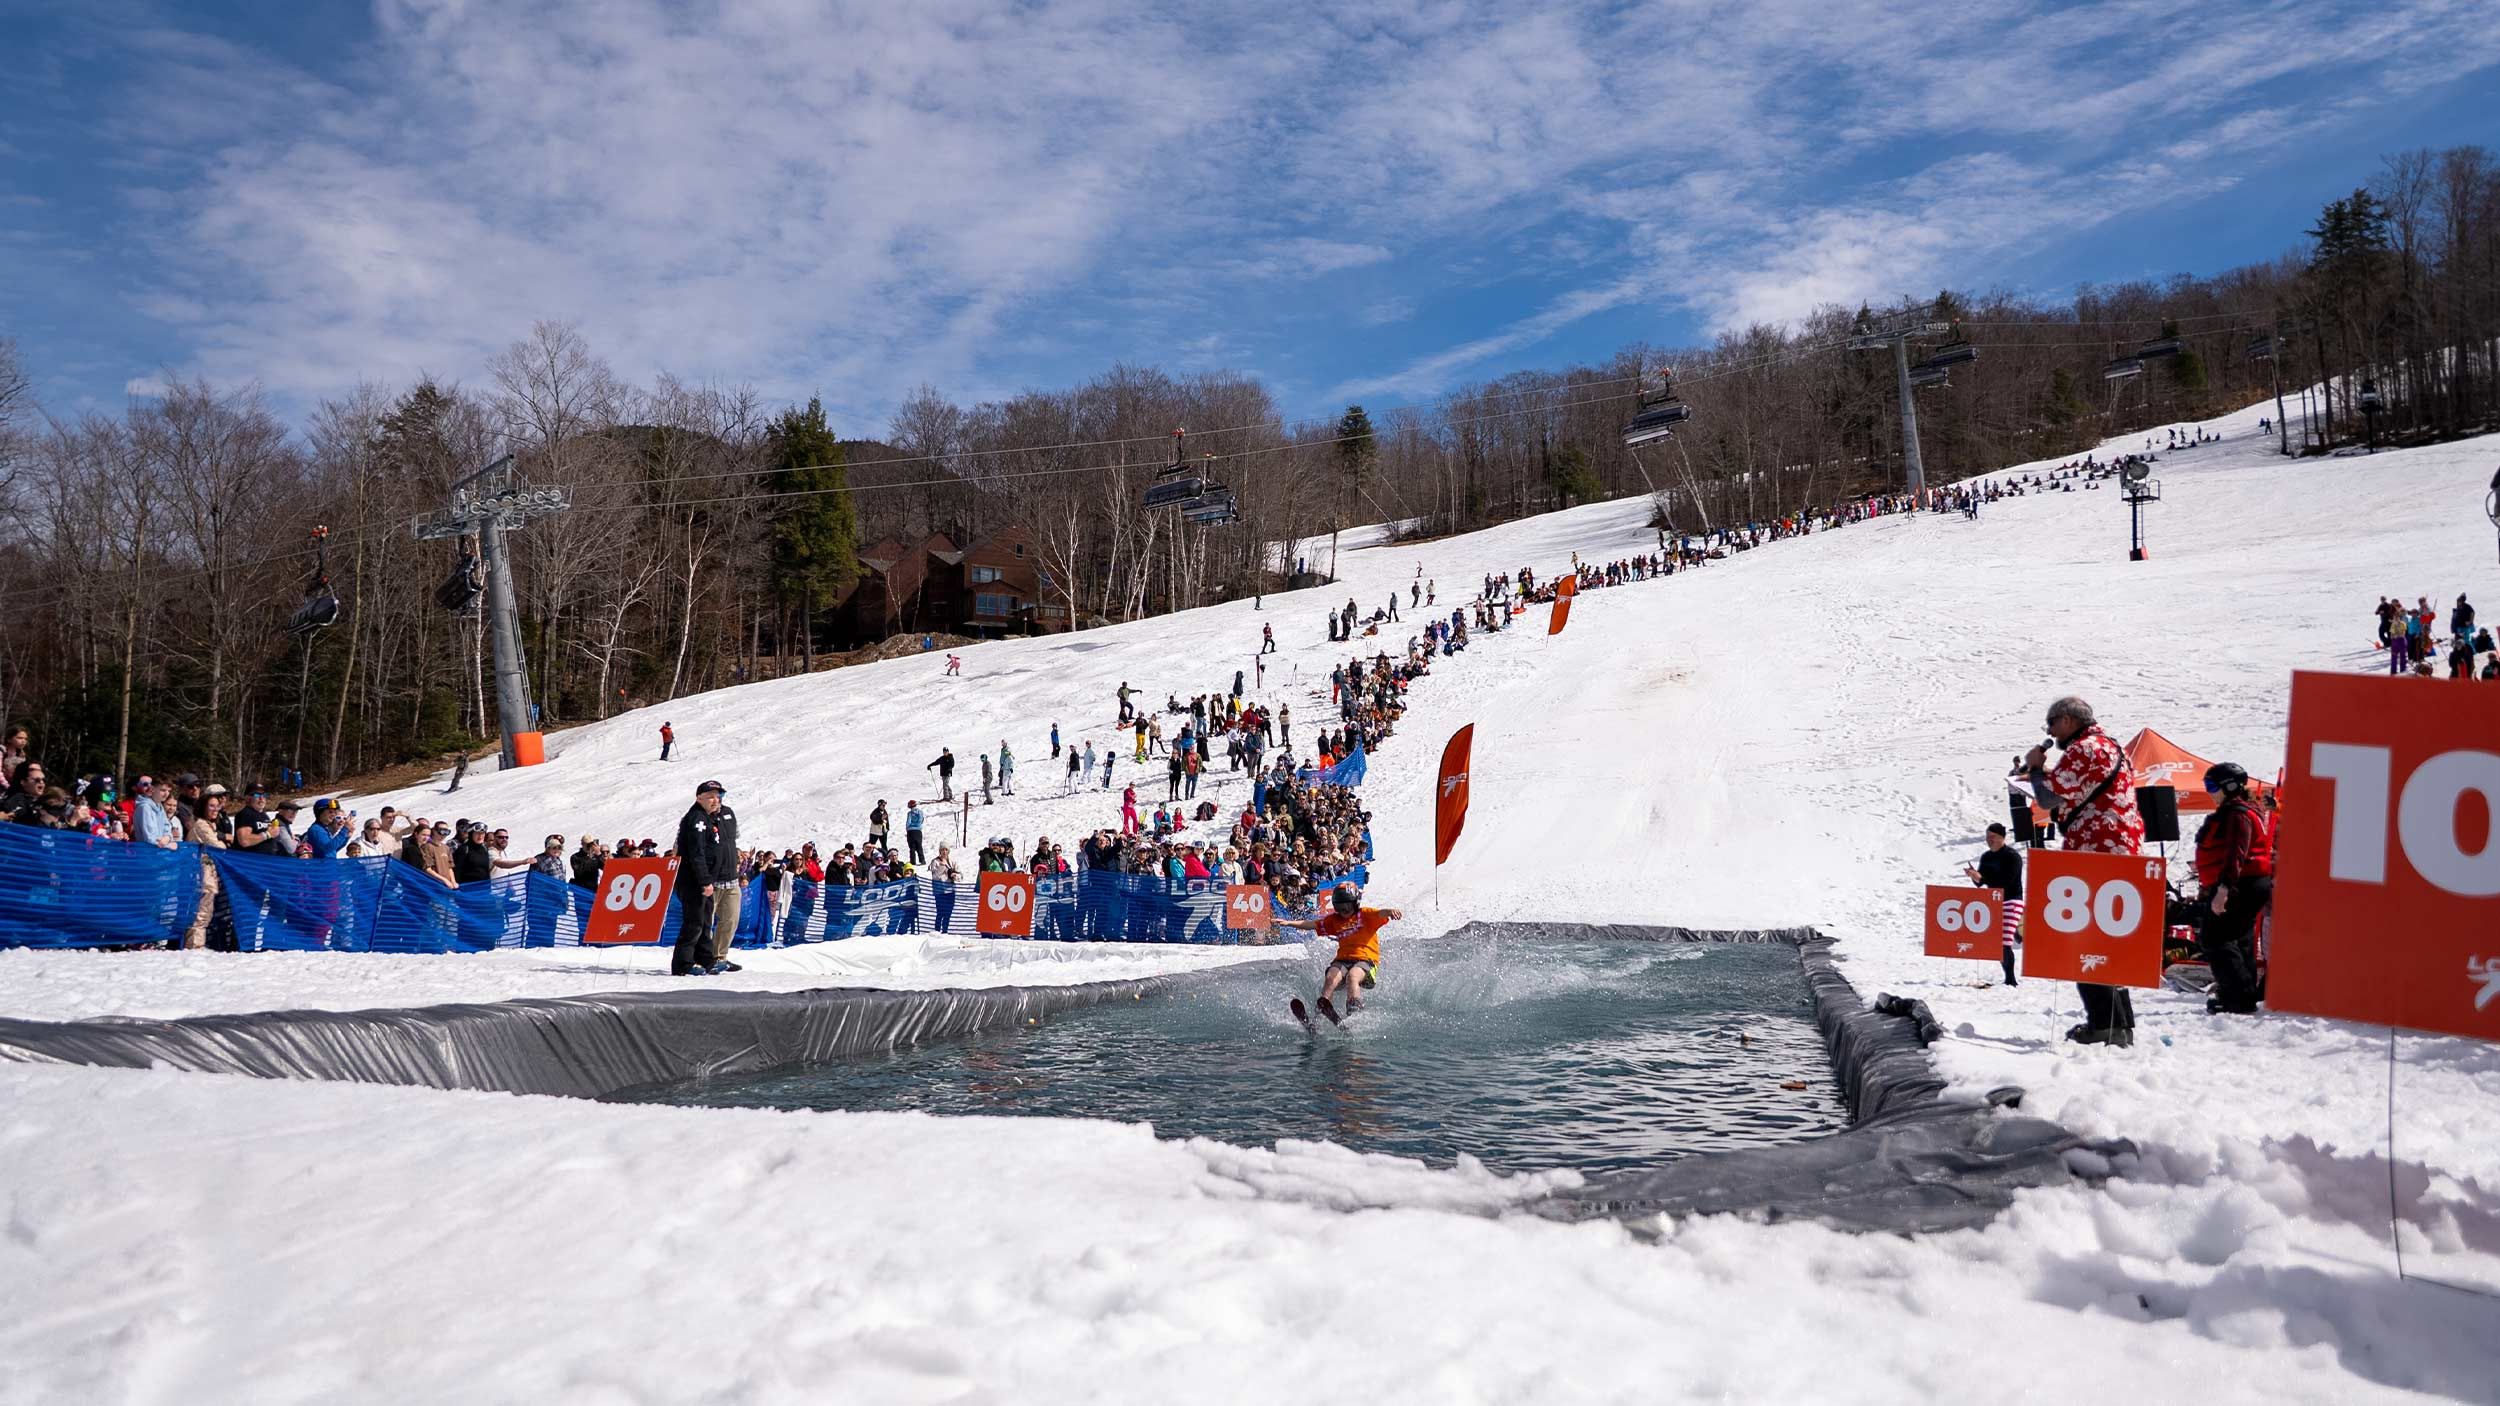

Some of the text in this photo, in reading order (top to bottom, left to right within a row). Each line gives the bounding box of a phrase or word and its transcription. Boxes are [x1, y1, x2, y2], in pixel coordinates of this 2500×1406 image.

[2309, 741, 2500, 898] 10
[2145, 861, 2162, 879] ft
[605, 873, 662, 912] 80
[987, 883, 1026, 913] 60
[1232, 893, 1265, 913] 40
[1991, 890, 2002, 901] ft
[2043, 875, 2143, 937] 80
[1936, 899, 1991, 934] 60
